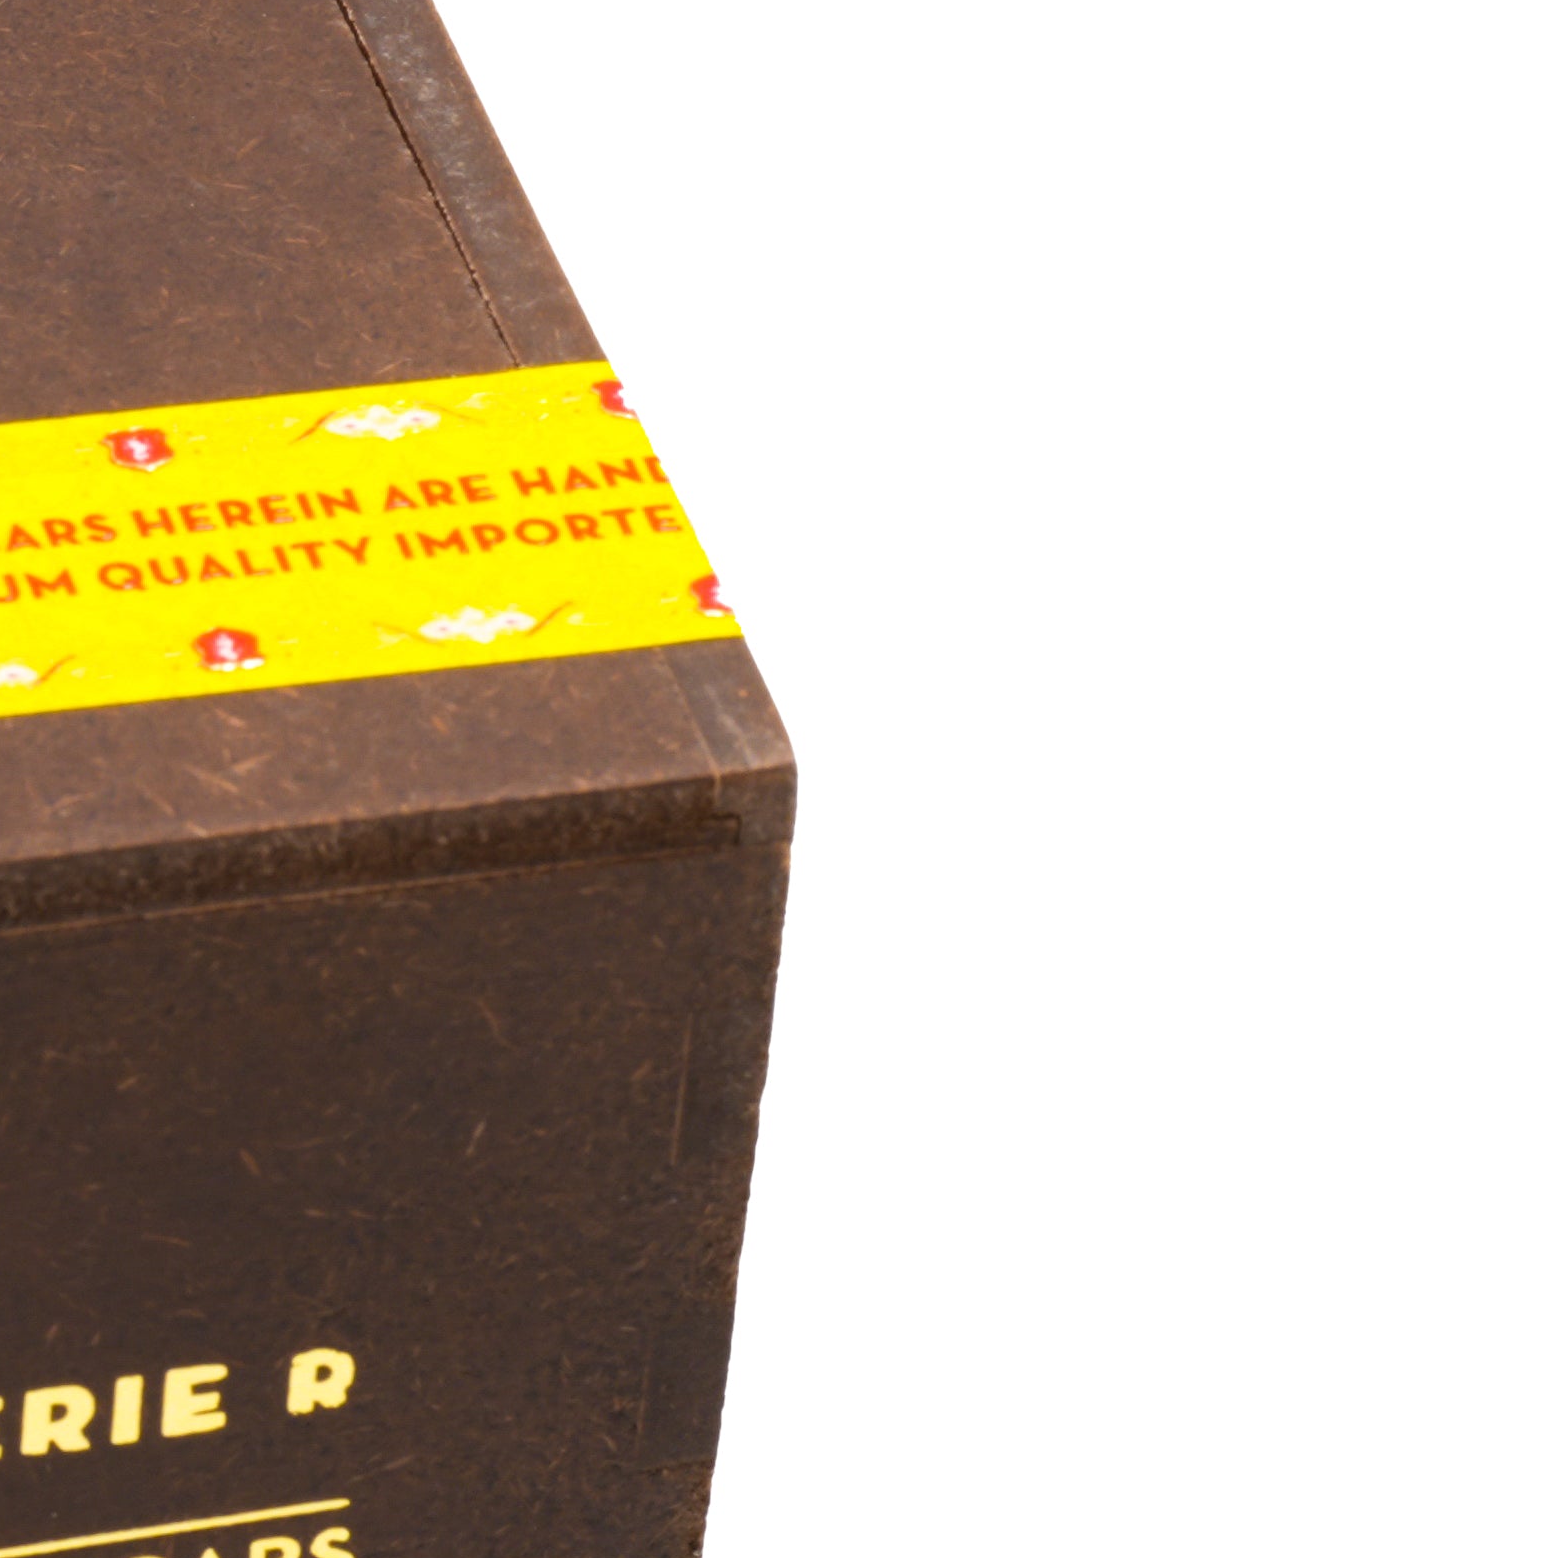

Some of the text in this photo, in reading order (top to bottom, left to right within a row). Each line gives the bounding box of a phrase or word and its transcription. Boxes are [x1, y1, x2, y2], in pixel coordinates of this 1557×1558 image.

[132, 488, 361, 538] HEREIN
[384, 474, 497, 512] ARE
[97, 536, 370, 592] QUALITY
[394, 504, 682, 560] IMPORTE
[286, 1347, 356, 1416] R
